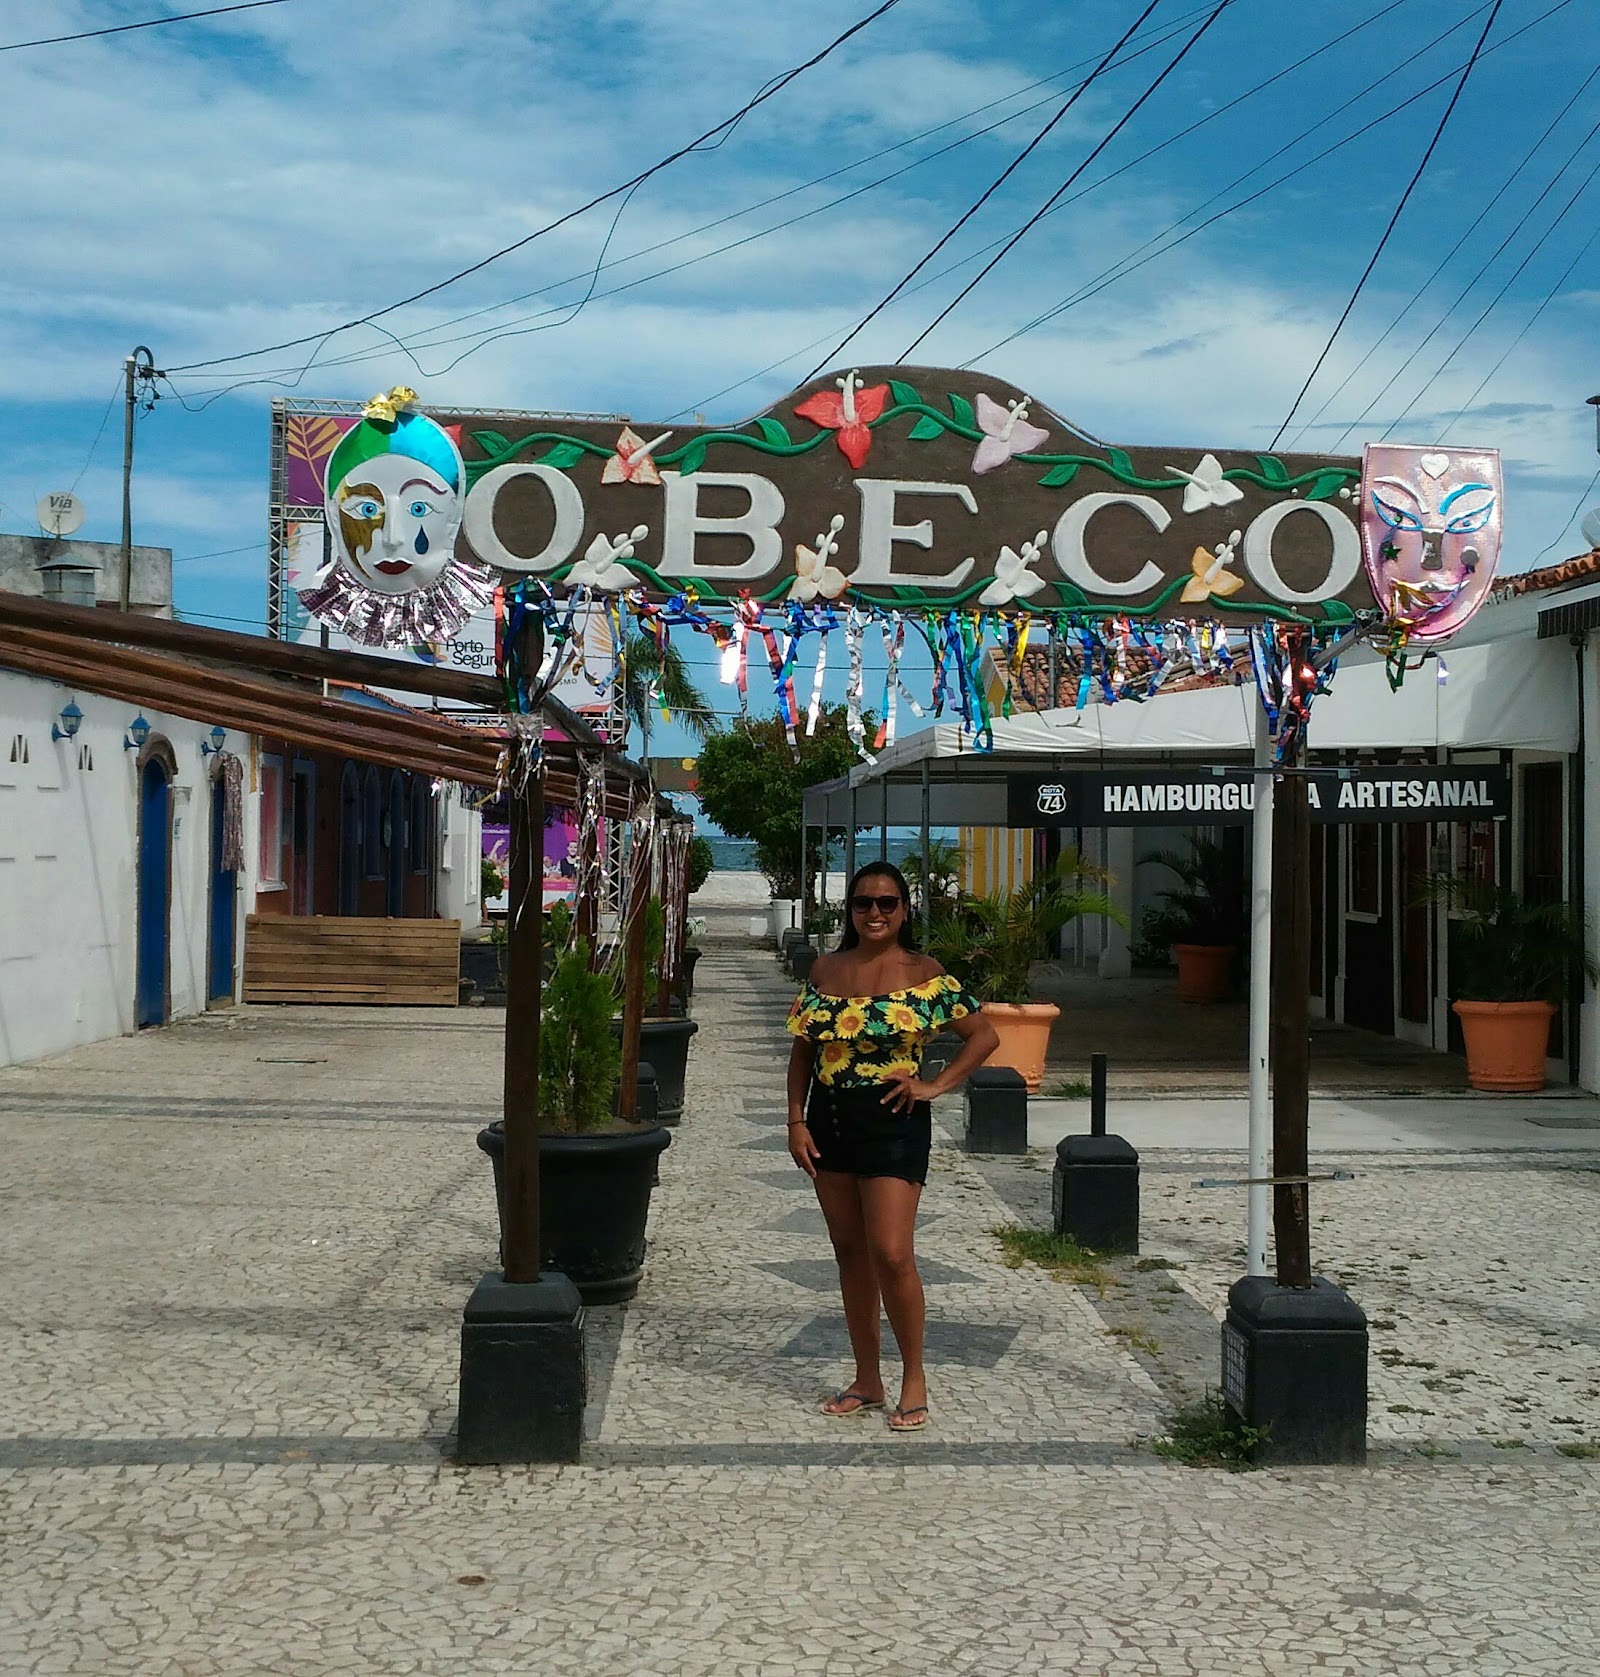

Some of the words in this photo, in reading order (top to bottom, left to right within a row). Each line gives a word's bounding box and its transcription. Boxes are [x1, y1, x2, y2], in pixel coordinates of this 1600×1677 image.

[49, 495, 73, 509] Via
[446, 639, 484, 653] Porto
[452, 651, 497, 669] Segur
[1042, 795, 1062, 810] 74
[1104, 782, 1322, 813] HAMBURGUA
[1338, 780, 1495, 809] ARTESANAL
